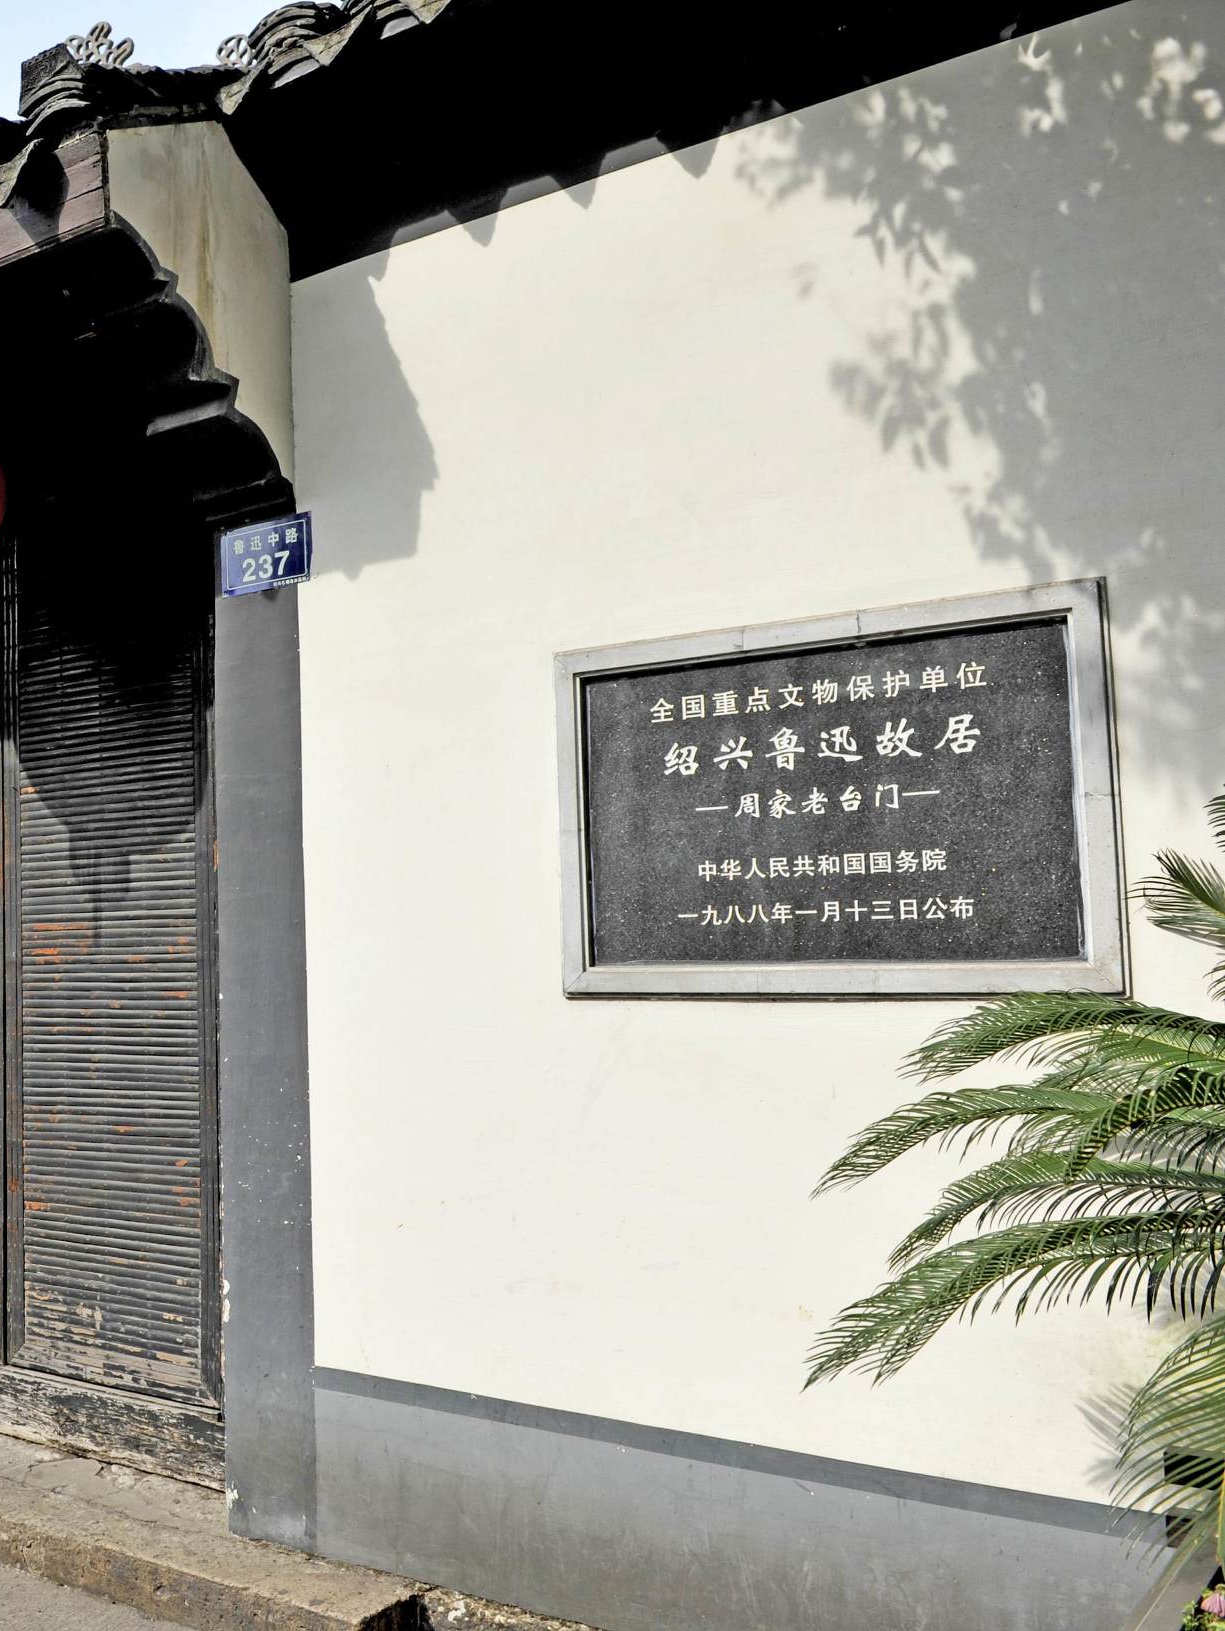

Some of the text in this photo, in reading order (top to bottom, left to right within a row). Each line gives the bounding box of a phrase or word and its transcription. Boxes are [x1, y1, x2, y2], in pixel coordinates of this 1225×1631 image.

[232, 527, 298, 556] 鲁迅中路
[242, 550, 290, 583] 237
[649, 661, 988, 723] 全国重点文物保护单位
[663, 713, 981, 777] 绍兴鲁迅故居
[697, 849, 948, 883] 中华人民共和国国务院
[677, 896, 975, 927] 一九八八年一月十三日公布
